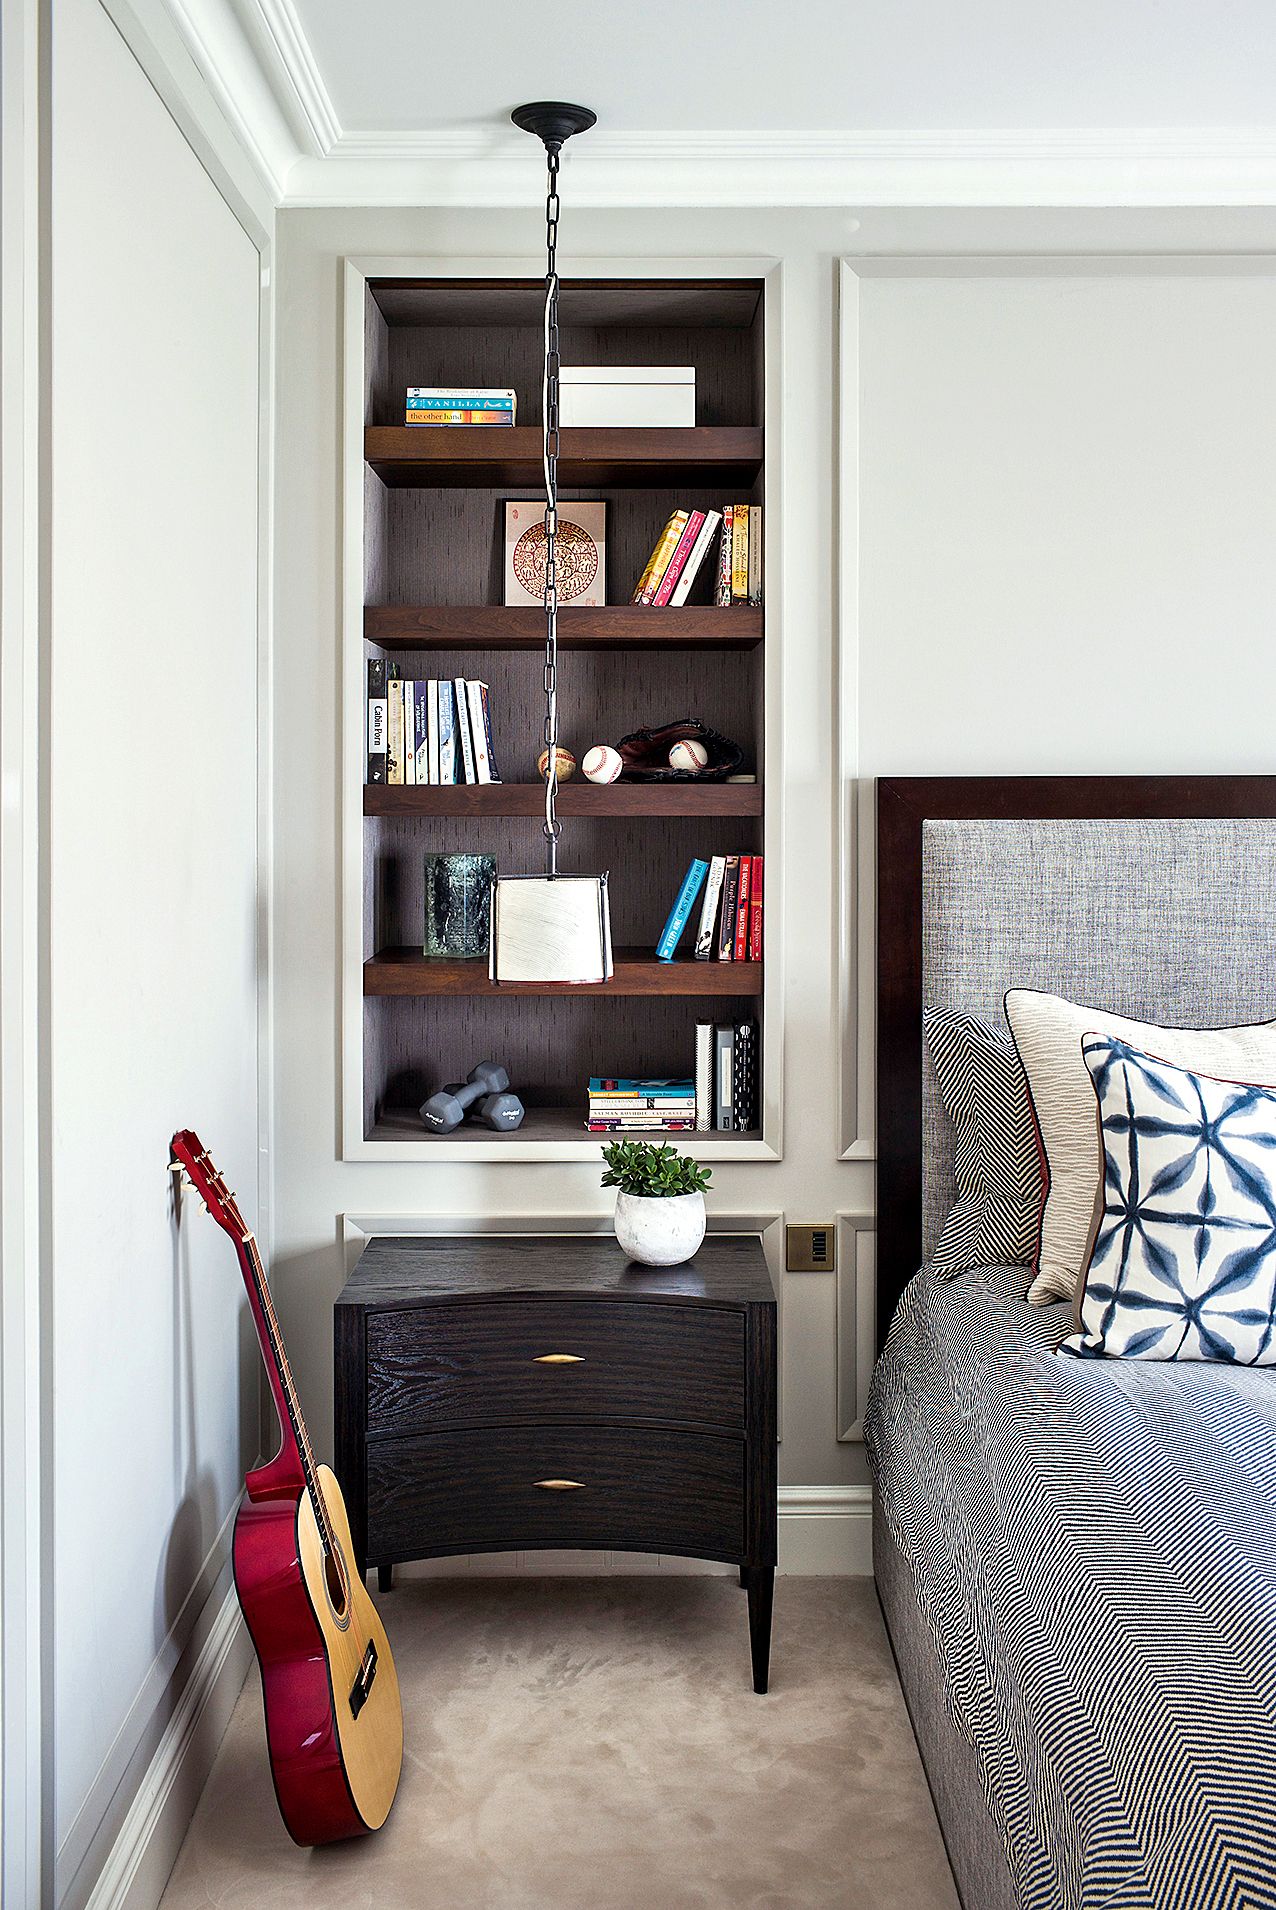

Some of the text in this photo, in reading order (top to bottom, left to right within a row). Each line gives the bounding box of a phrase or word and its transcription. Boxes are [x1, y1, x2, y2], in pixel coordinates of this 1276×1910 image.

[410, 412, 462, 420] the other hand
[675, 549, 687, 567] Three
[739, 551, 747, 575] Splendid
[668, 565, 679, 580] Cups
[662, 582, 671, 595] Tea
[373, 705, 383, 746] Cabin Porn
[726, 880, 736, 931] Purple Hibiscus
